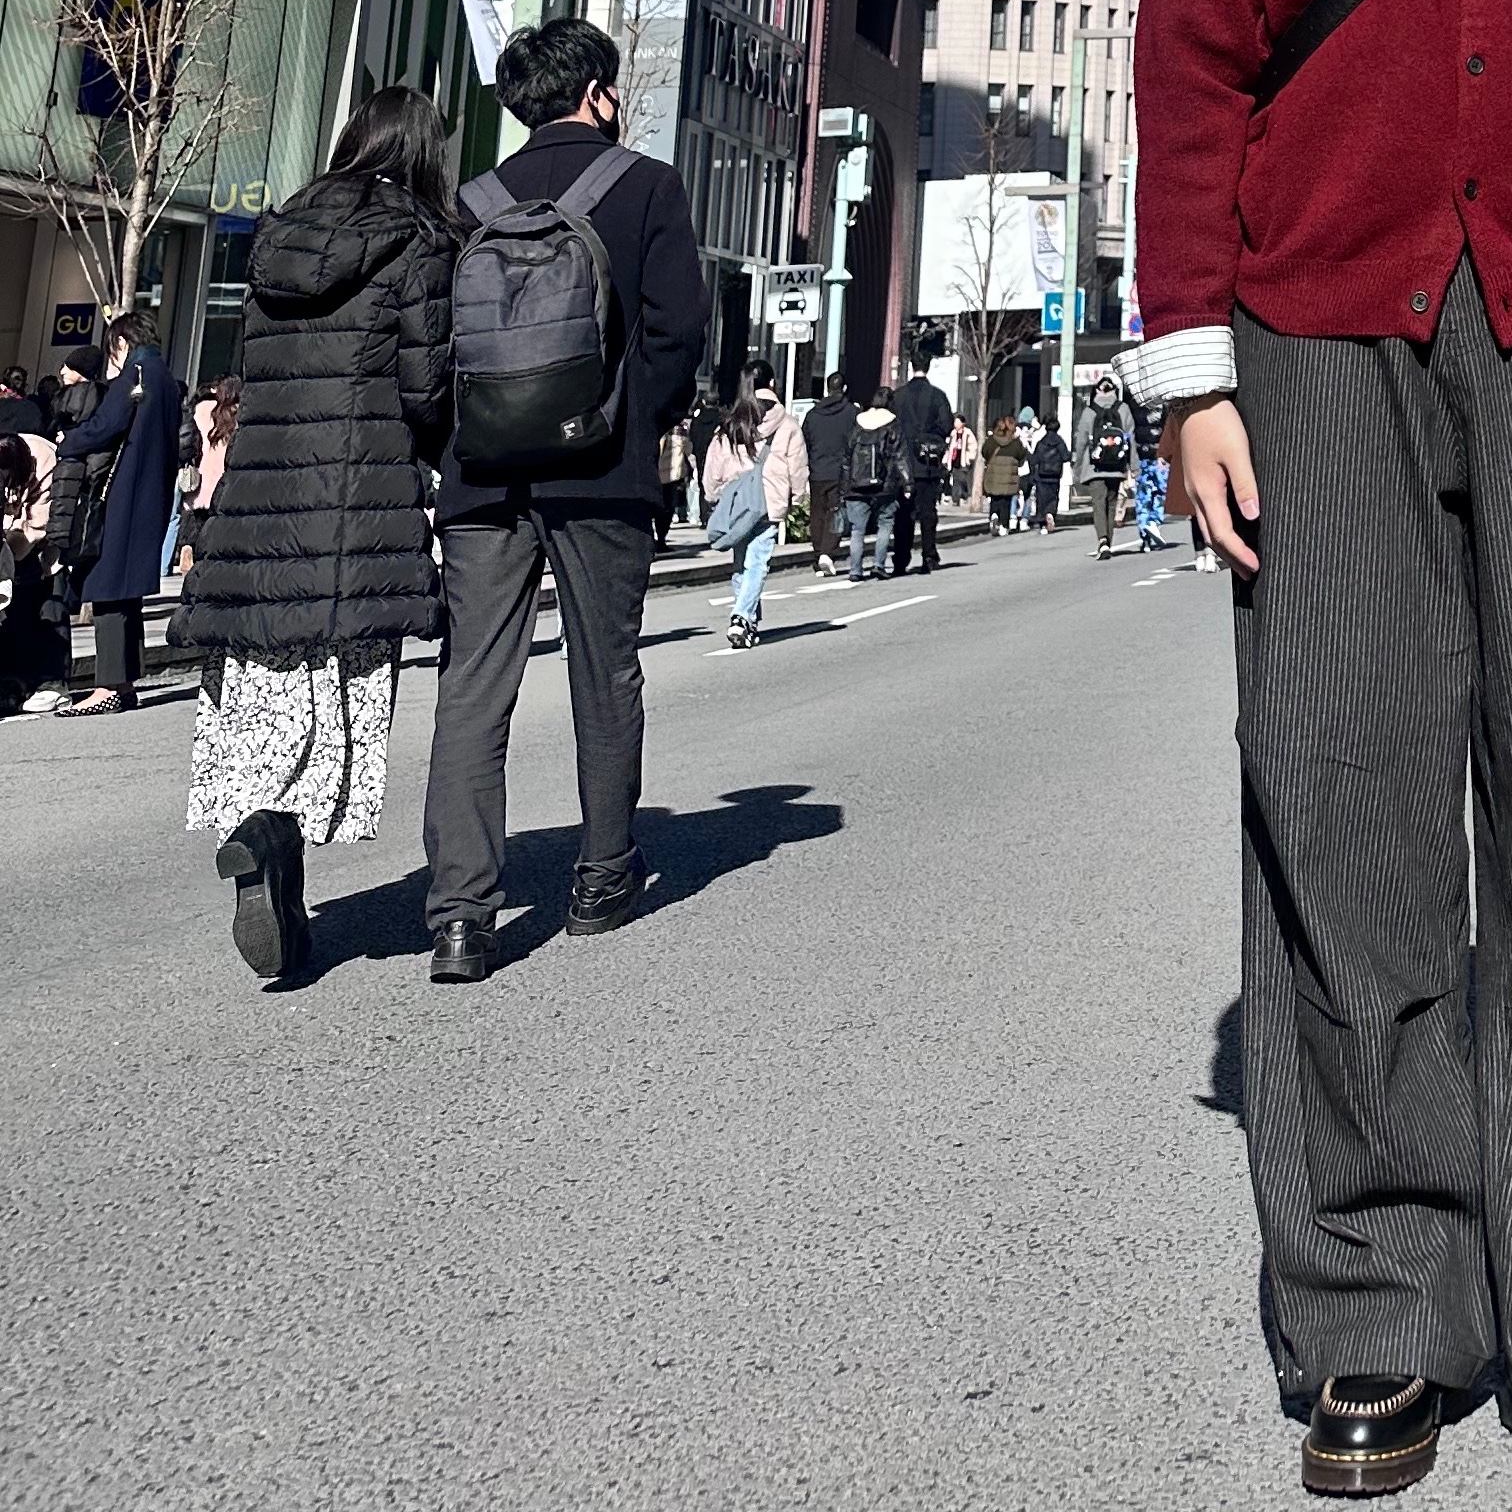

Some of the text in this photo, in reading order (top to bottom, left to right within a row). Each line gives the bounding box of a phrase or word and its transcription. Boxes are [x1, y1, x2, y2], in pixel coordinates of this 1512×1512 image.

[705, 14, 802, 118] TASAKI
[775, 270, 815, 285] TAXI
[57, 315, 92, 334] GU
